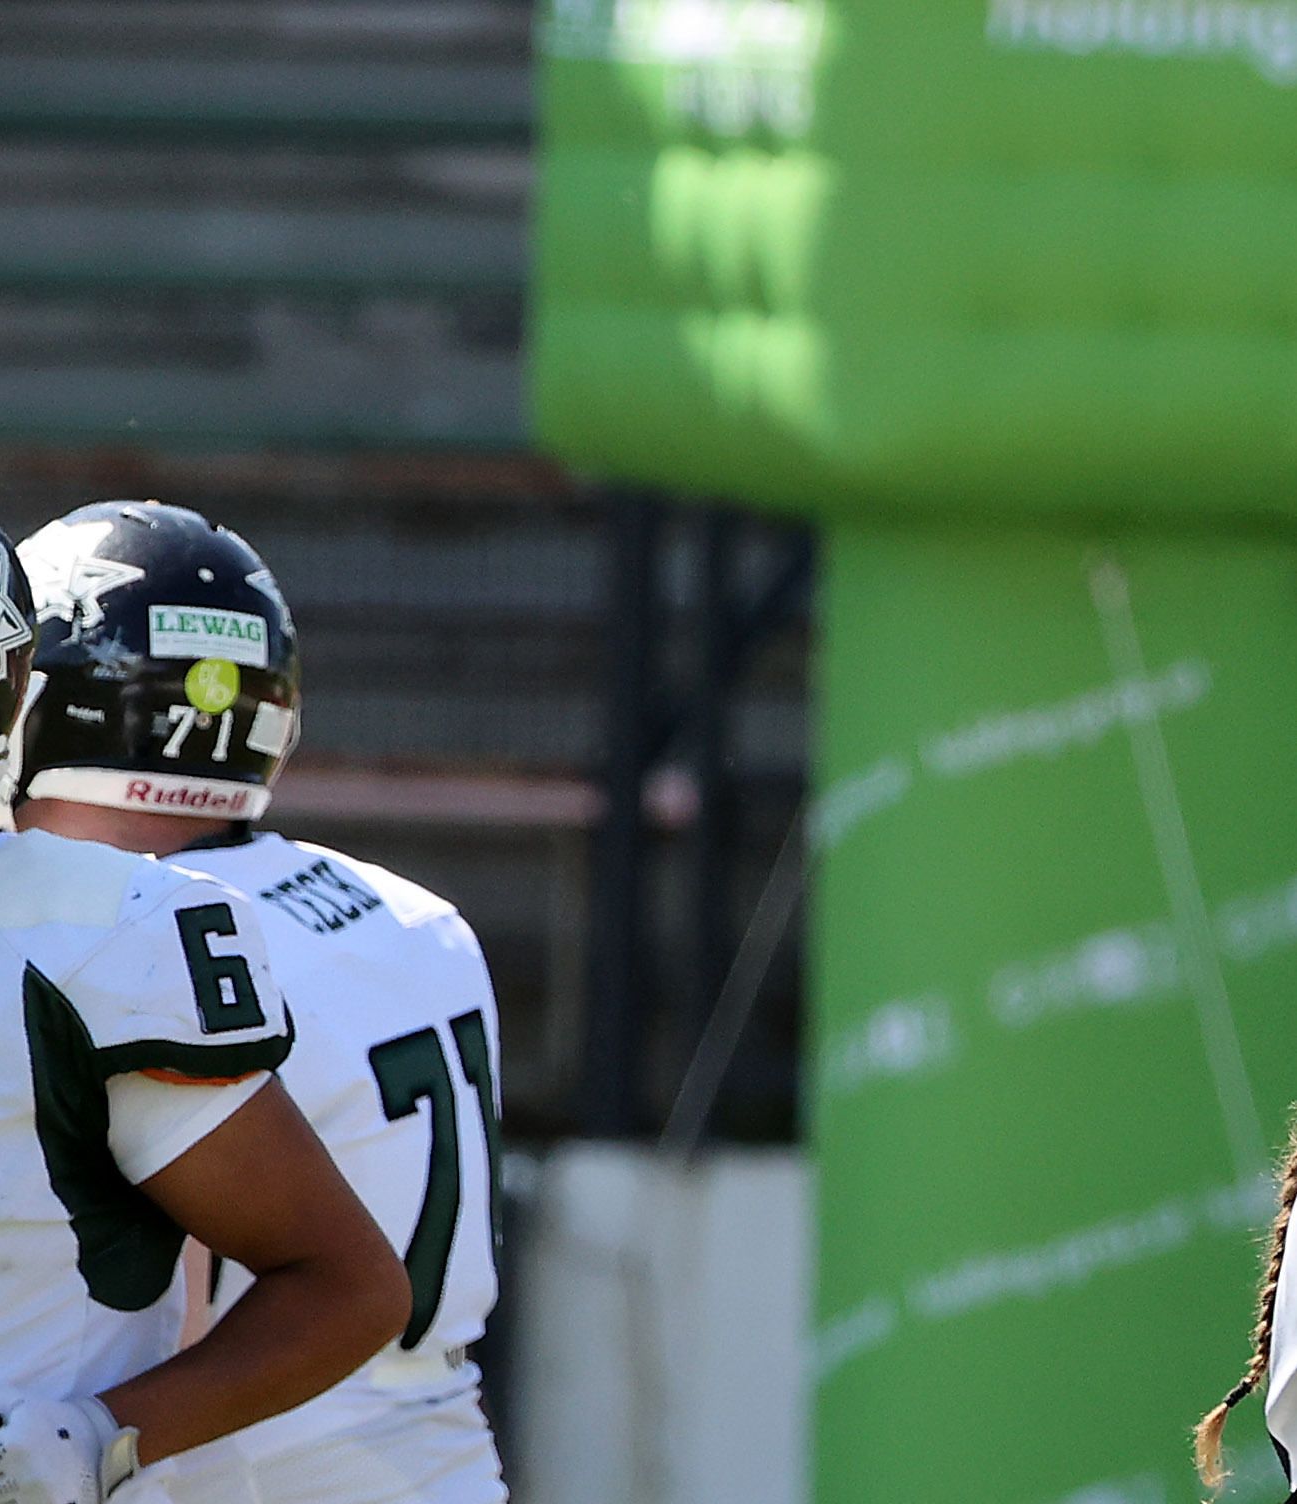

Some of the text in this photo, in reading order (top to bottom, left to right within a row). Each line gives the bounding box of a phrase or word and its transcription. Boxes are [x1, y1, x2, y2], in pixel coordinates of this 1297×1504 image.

[156, 612, 262, 642] LEWAG
[162, 704, 234, 762] 71
[126, 780, 249, 811] Riddell
[175, 903, 267, 1036] 6
